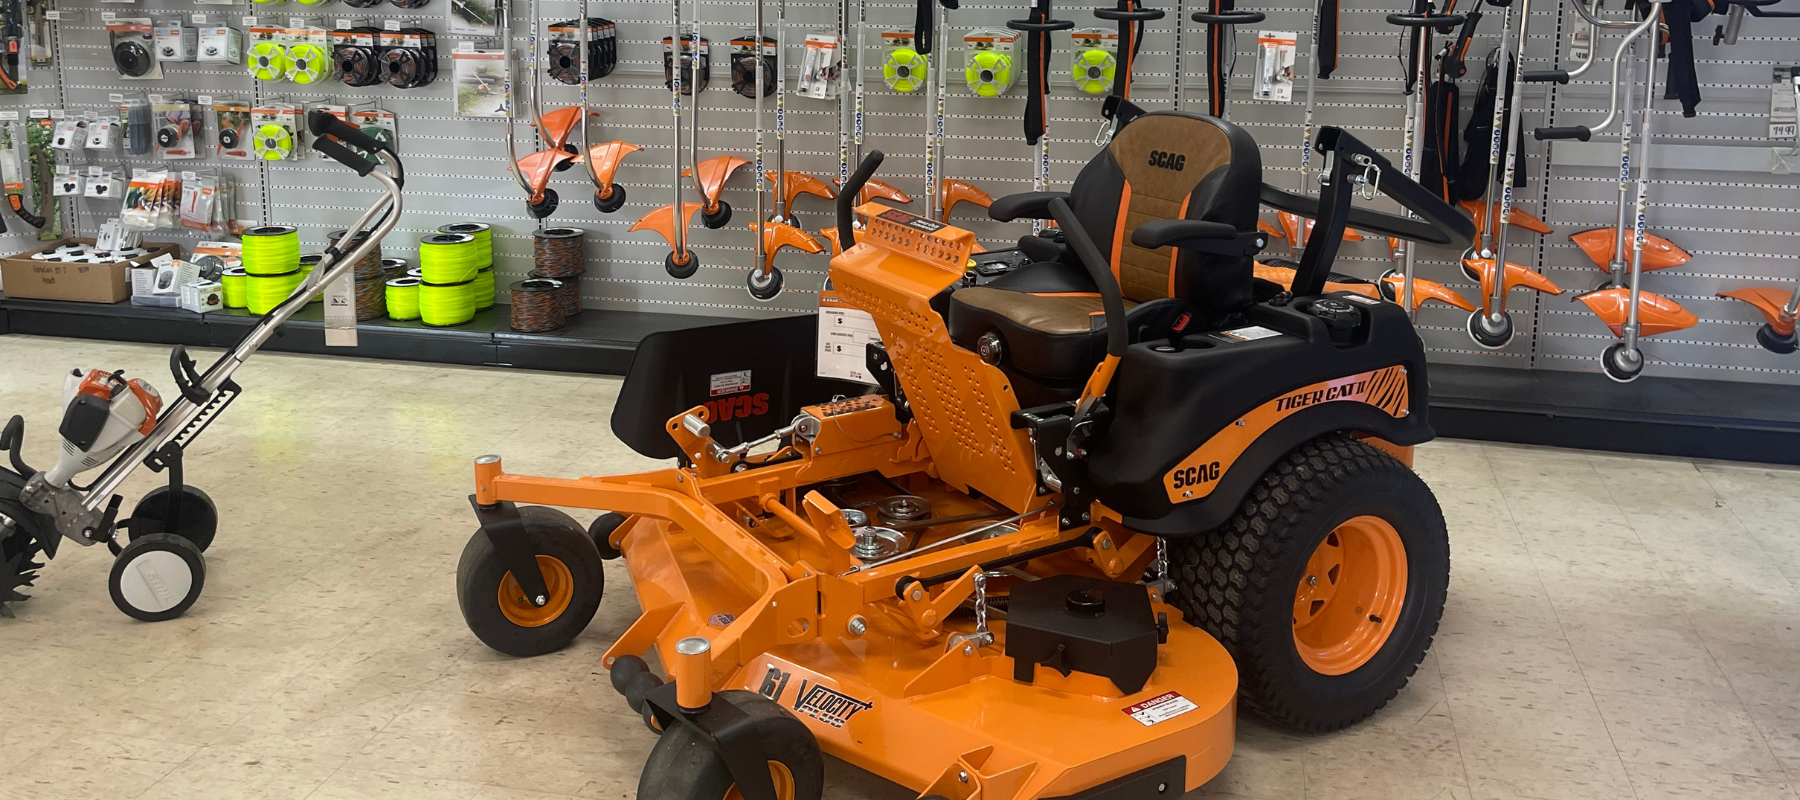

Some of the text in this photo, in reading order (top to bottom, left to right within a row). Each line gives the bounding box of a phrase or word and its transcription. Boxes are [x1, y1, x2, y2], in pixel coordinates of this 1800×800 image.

[1148, 150, 1186, 172] SCAG
[1275, 389, 1324, 412] TIGER
[1325, 382, 1359, 401] CAT
[1173, 461, 1220, 489] SCAG
[758, 667, 791, 703] 61
[1140, 693, 1175, 709] DANGER
[798, 704, 846, 729] PLUS
